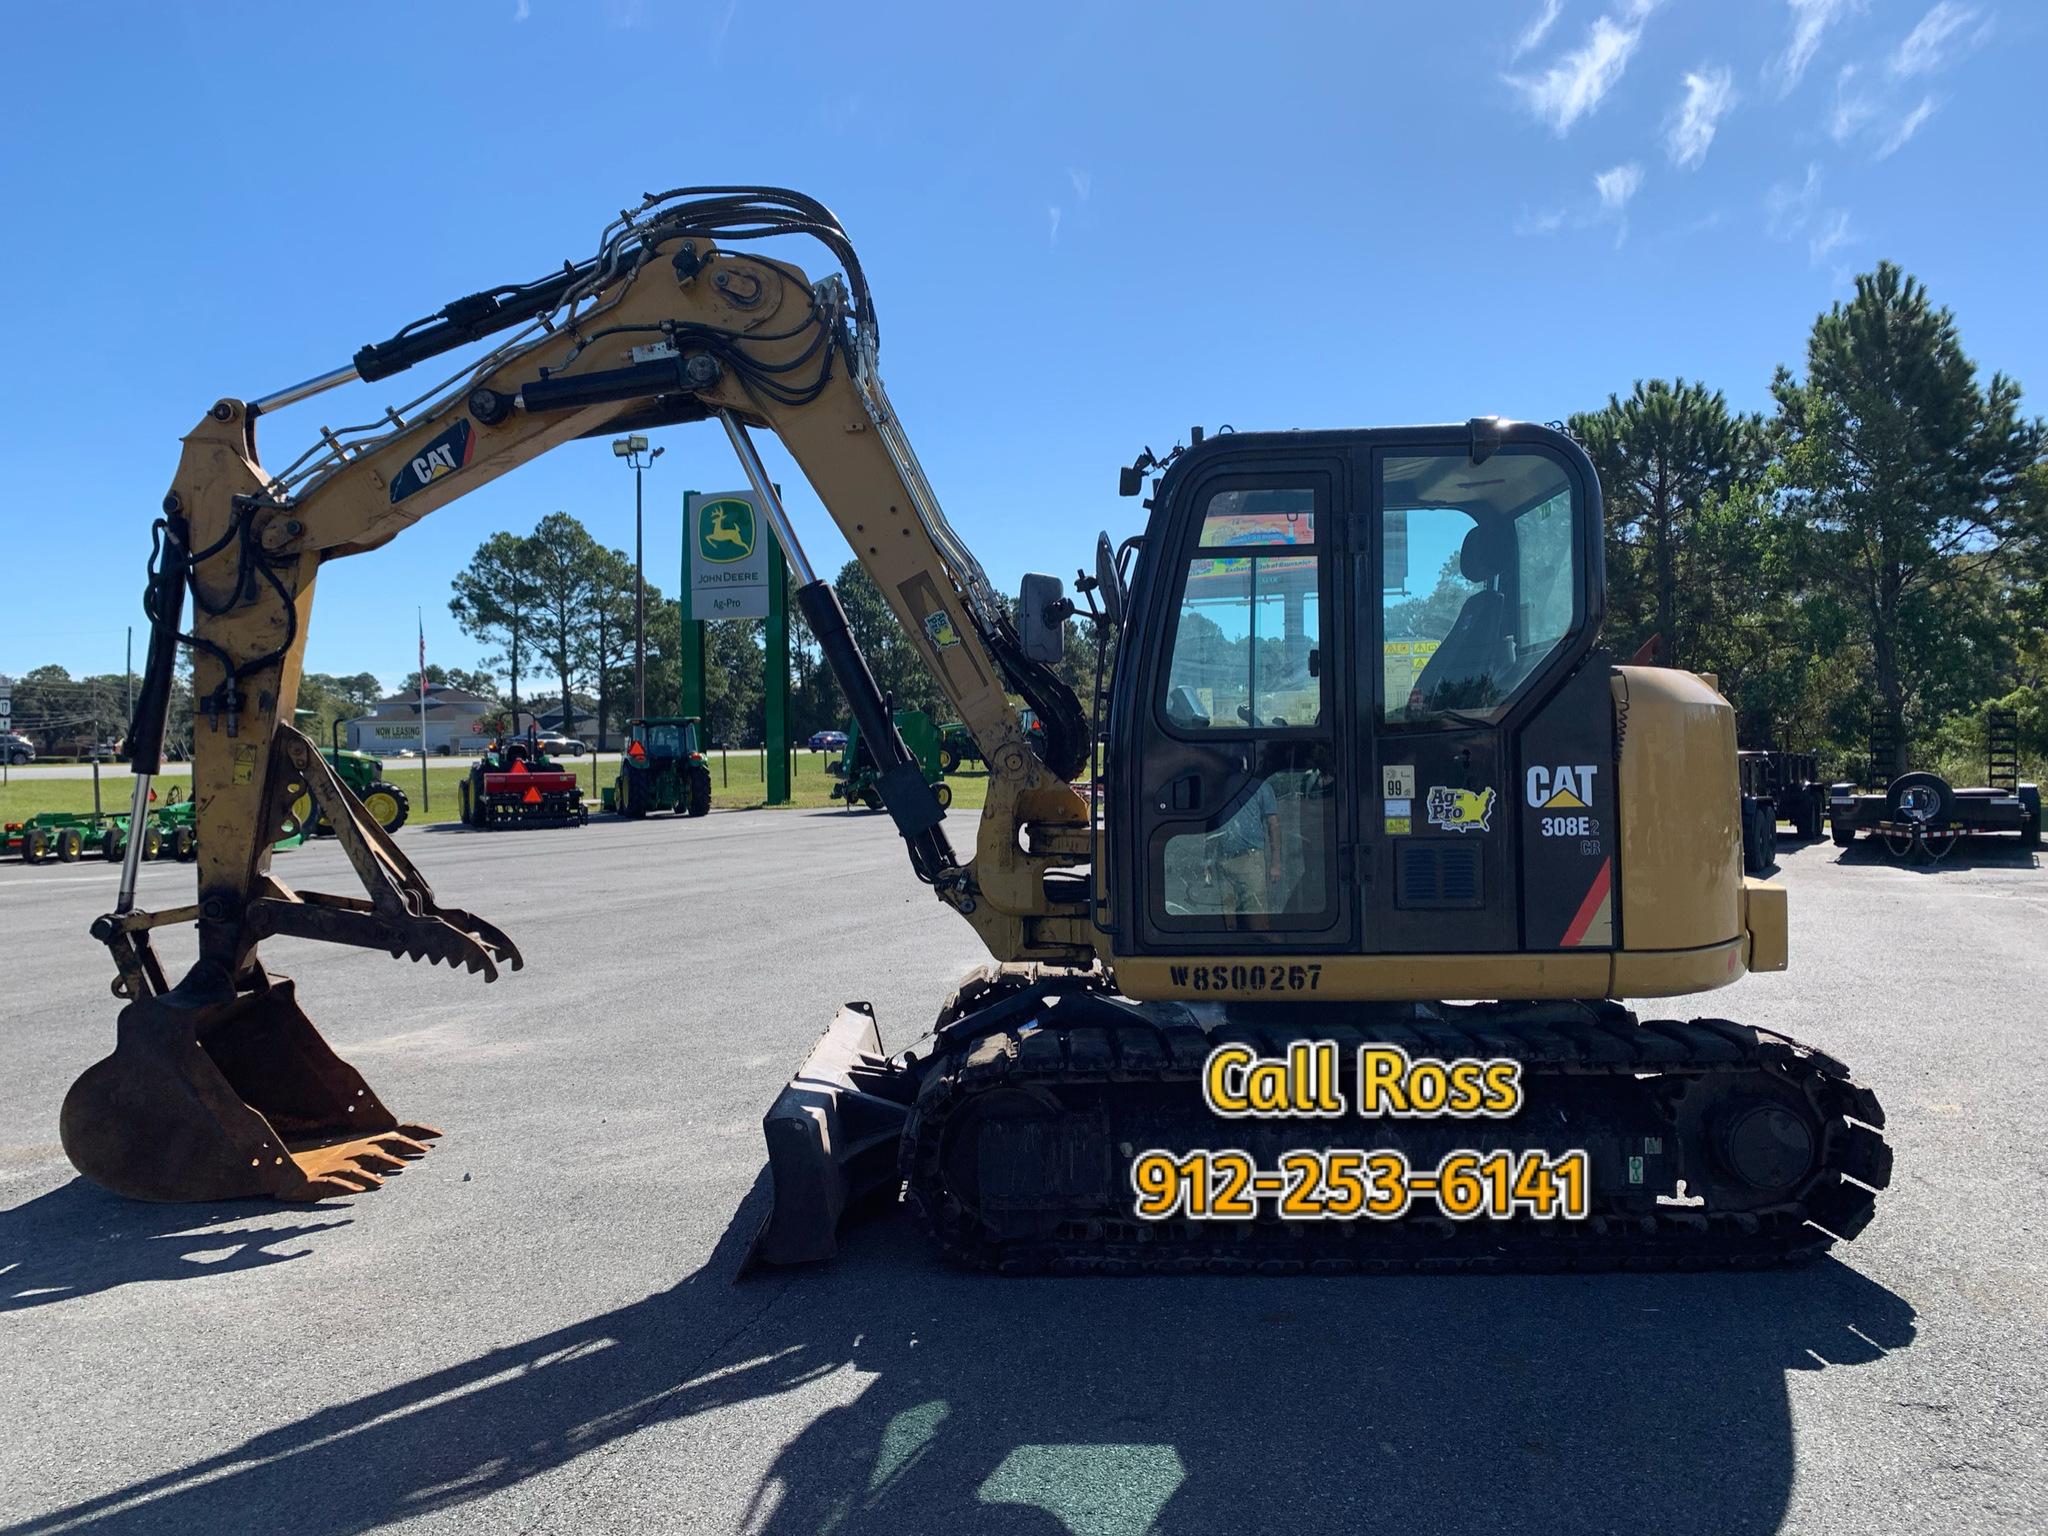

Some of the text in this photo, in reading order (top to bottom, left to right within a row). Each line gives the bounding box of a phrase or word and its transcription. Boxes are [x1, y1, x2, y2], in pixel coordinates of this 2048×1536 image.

[412, 443, 457, 484] CAT
[698, 572, 759, 584] JOHN DEERE
[713, 598, 741, 610] Ag-Pro
[375, 726, 420, 736] NOW LEASING
[1387, 780, 1402, 796] 99
[1526, 765, 1598, 808] CAT
[1431, 789, 1463, 808] Ag-
[1431, 804, 1463, 820] Pro
[1580, 839, 1600, 855] CR
